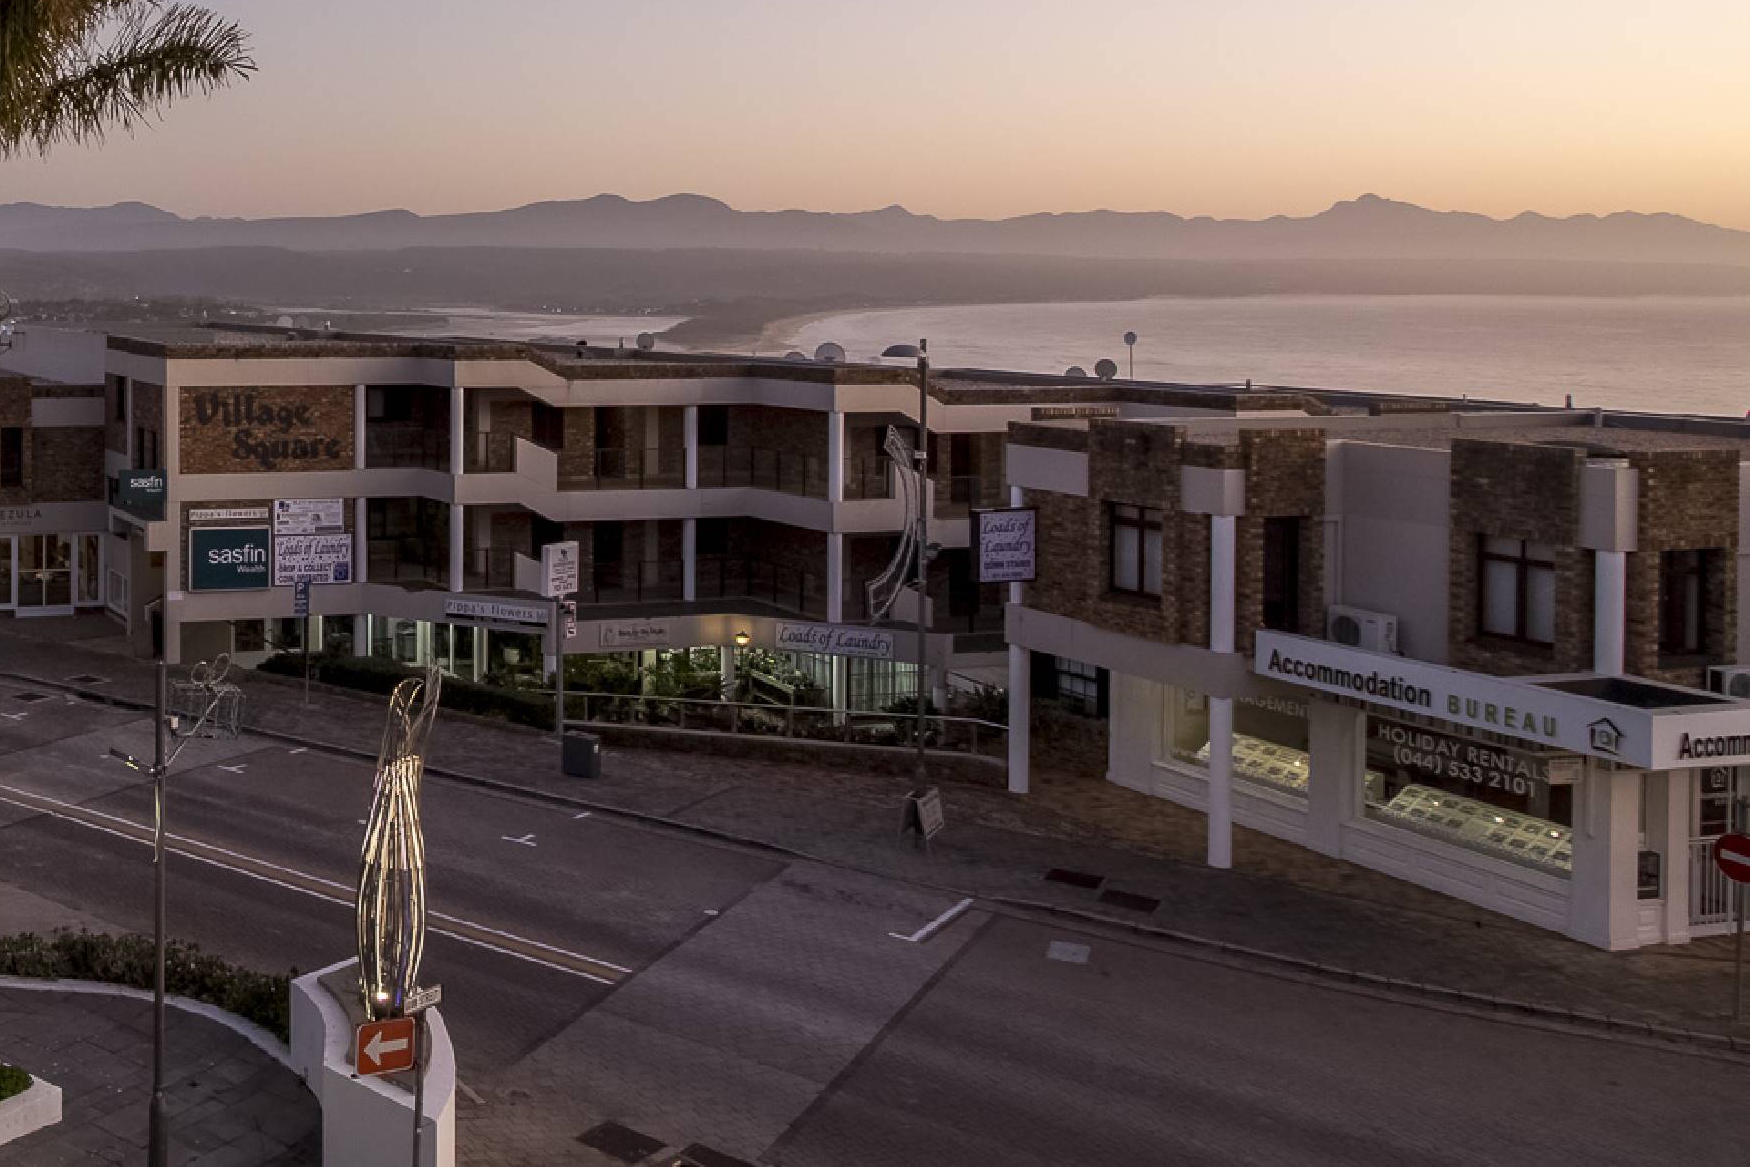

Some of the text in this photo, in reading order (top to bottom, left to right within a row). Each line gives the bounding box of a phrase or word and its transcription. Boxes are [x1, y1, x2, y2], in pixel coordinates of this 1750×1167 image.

[195, 390, 312, 433] Village
[233, 428, 341, 470] Square
[131, 476, 162, 488] sasfin
[983, 516, 1016, 534] Loads
[209, 543, 266, 563] sasfin
[985, 540, 1031, 554] Laundry
[779, 626, 817, 643] Loads
[835, 631, 891, 655] Laundry
[1268, 649, 1557, 737] Accommodation BUREAU
[1378, 723, 1460, 758] HOLIDAY
[1467, 746, 1550, 781] RENTALS
[1394, 745, 1535, 798] (044) 533 2101
